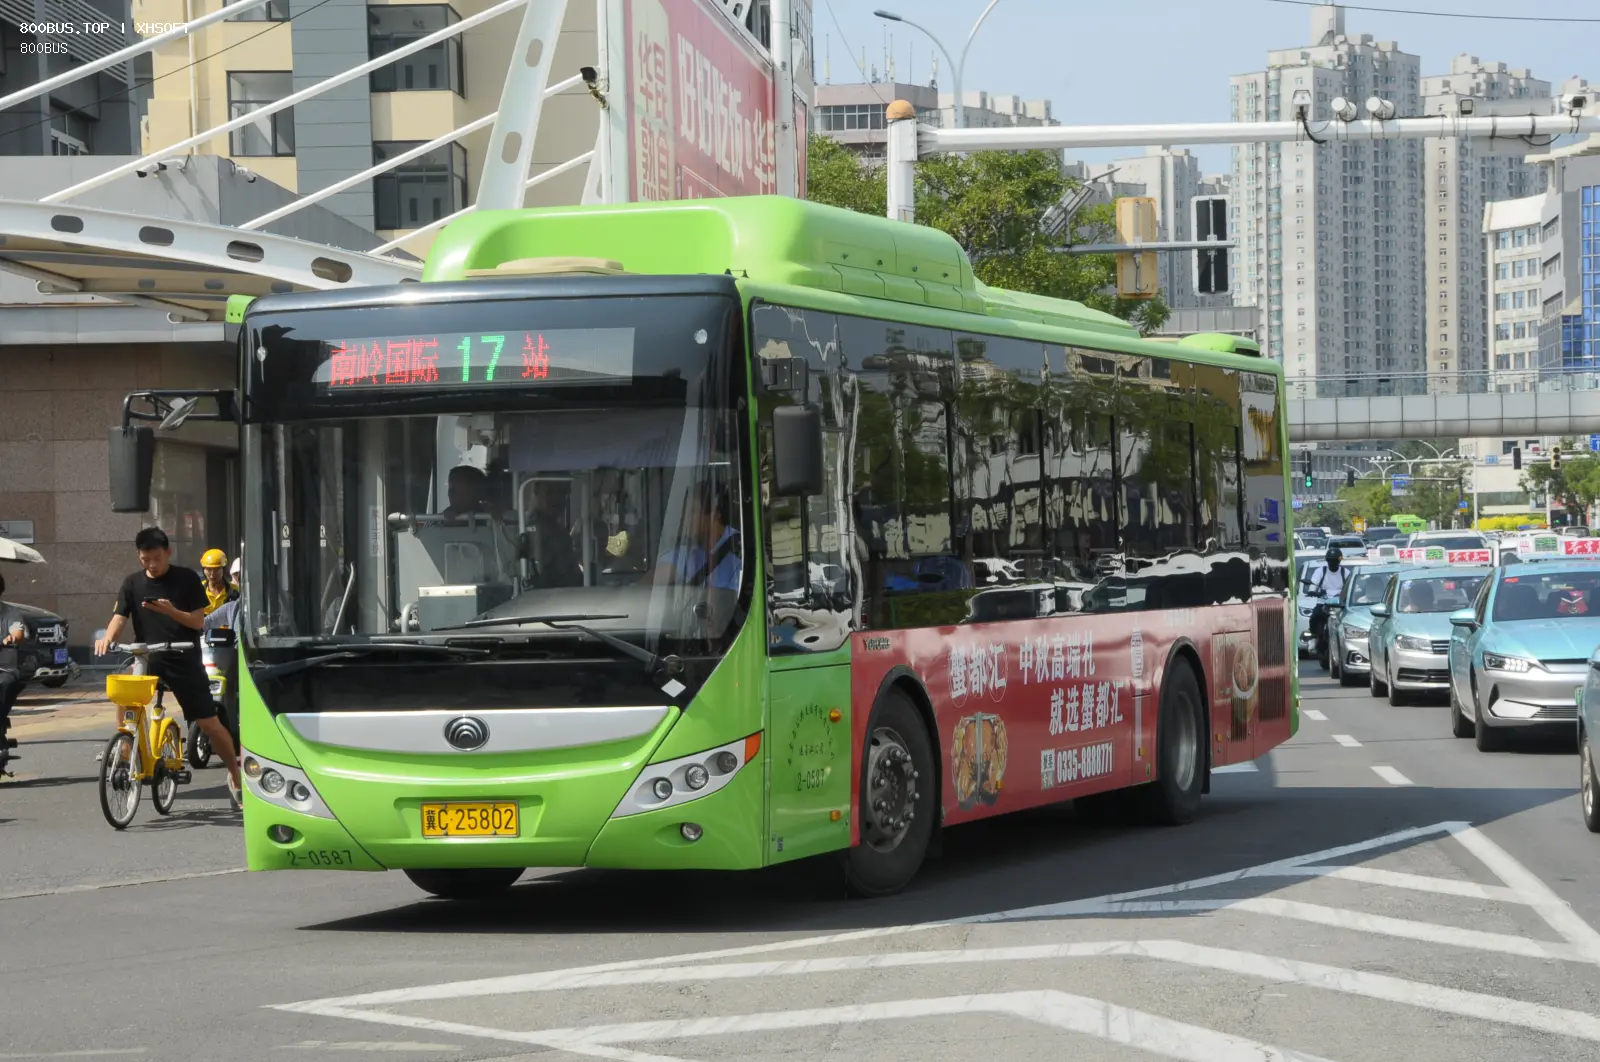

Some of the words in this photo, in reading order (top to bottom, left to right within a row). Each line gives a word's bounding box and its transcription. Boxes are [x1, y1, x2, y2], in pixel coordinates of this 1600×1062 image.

[330, 337, 440, 387] 南岭国际
[457, 335, 505, 382] 17
[522, 333, 550, 379] 站
[949, 642, 1007, 699] 蟹都汇
[1019, 630, 1096, 685] 中秋高端礼
[1049, 680, 1125, 736] 就选蟹都汇
[797, 768, 825, 792] 2-0587
[1057, 742, 1113, 784] 0335-8888771
[287, 850, 353, 866] 2-0587
